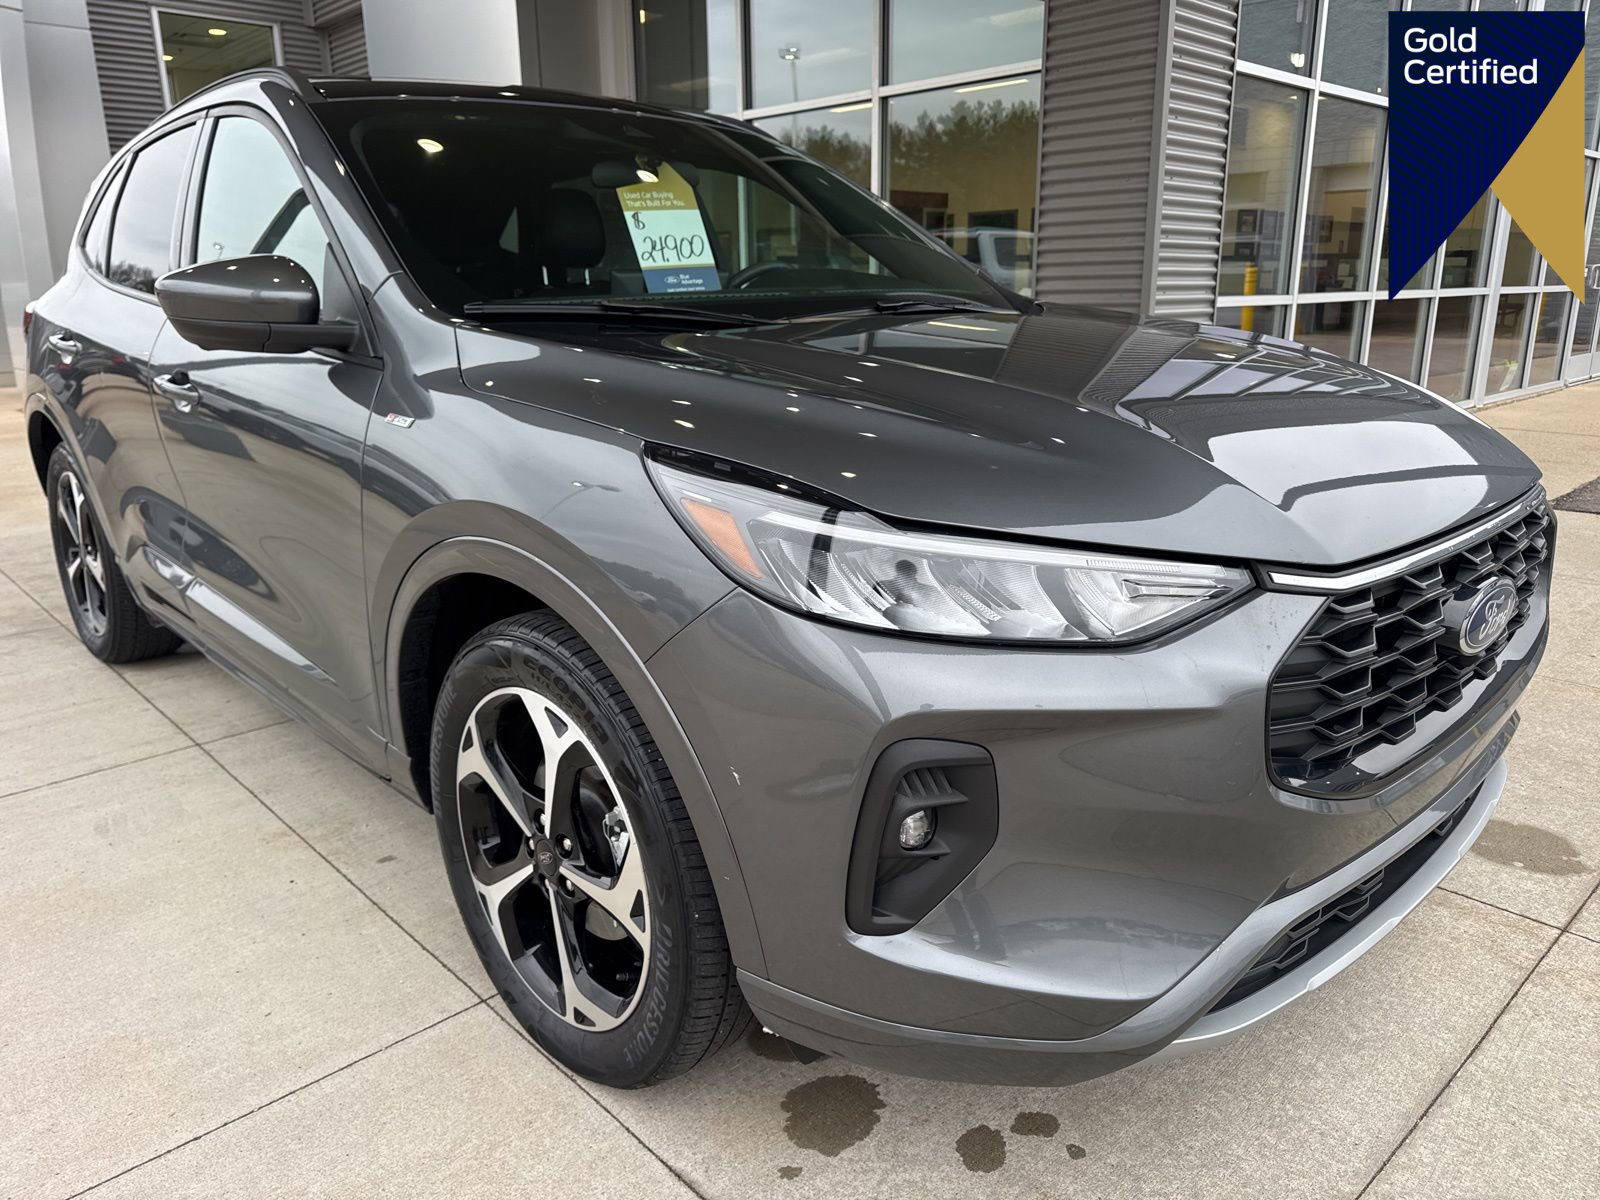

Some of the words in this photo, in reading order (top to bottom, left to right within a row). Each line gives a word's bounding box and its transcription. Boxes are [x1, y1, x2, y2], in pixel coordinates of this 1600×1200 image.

[624, 191, 640, 199] Used
[641, 191, 651, 199] Car
[660, 199, 671, 207] For
[1479, 594, 1511, 641] Ford
